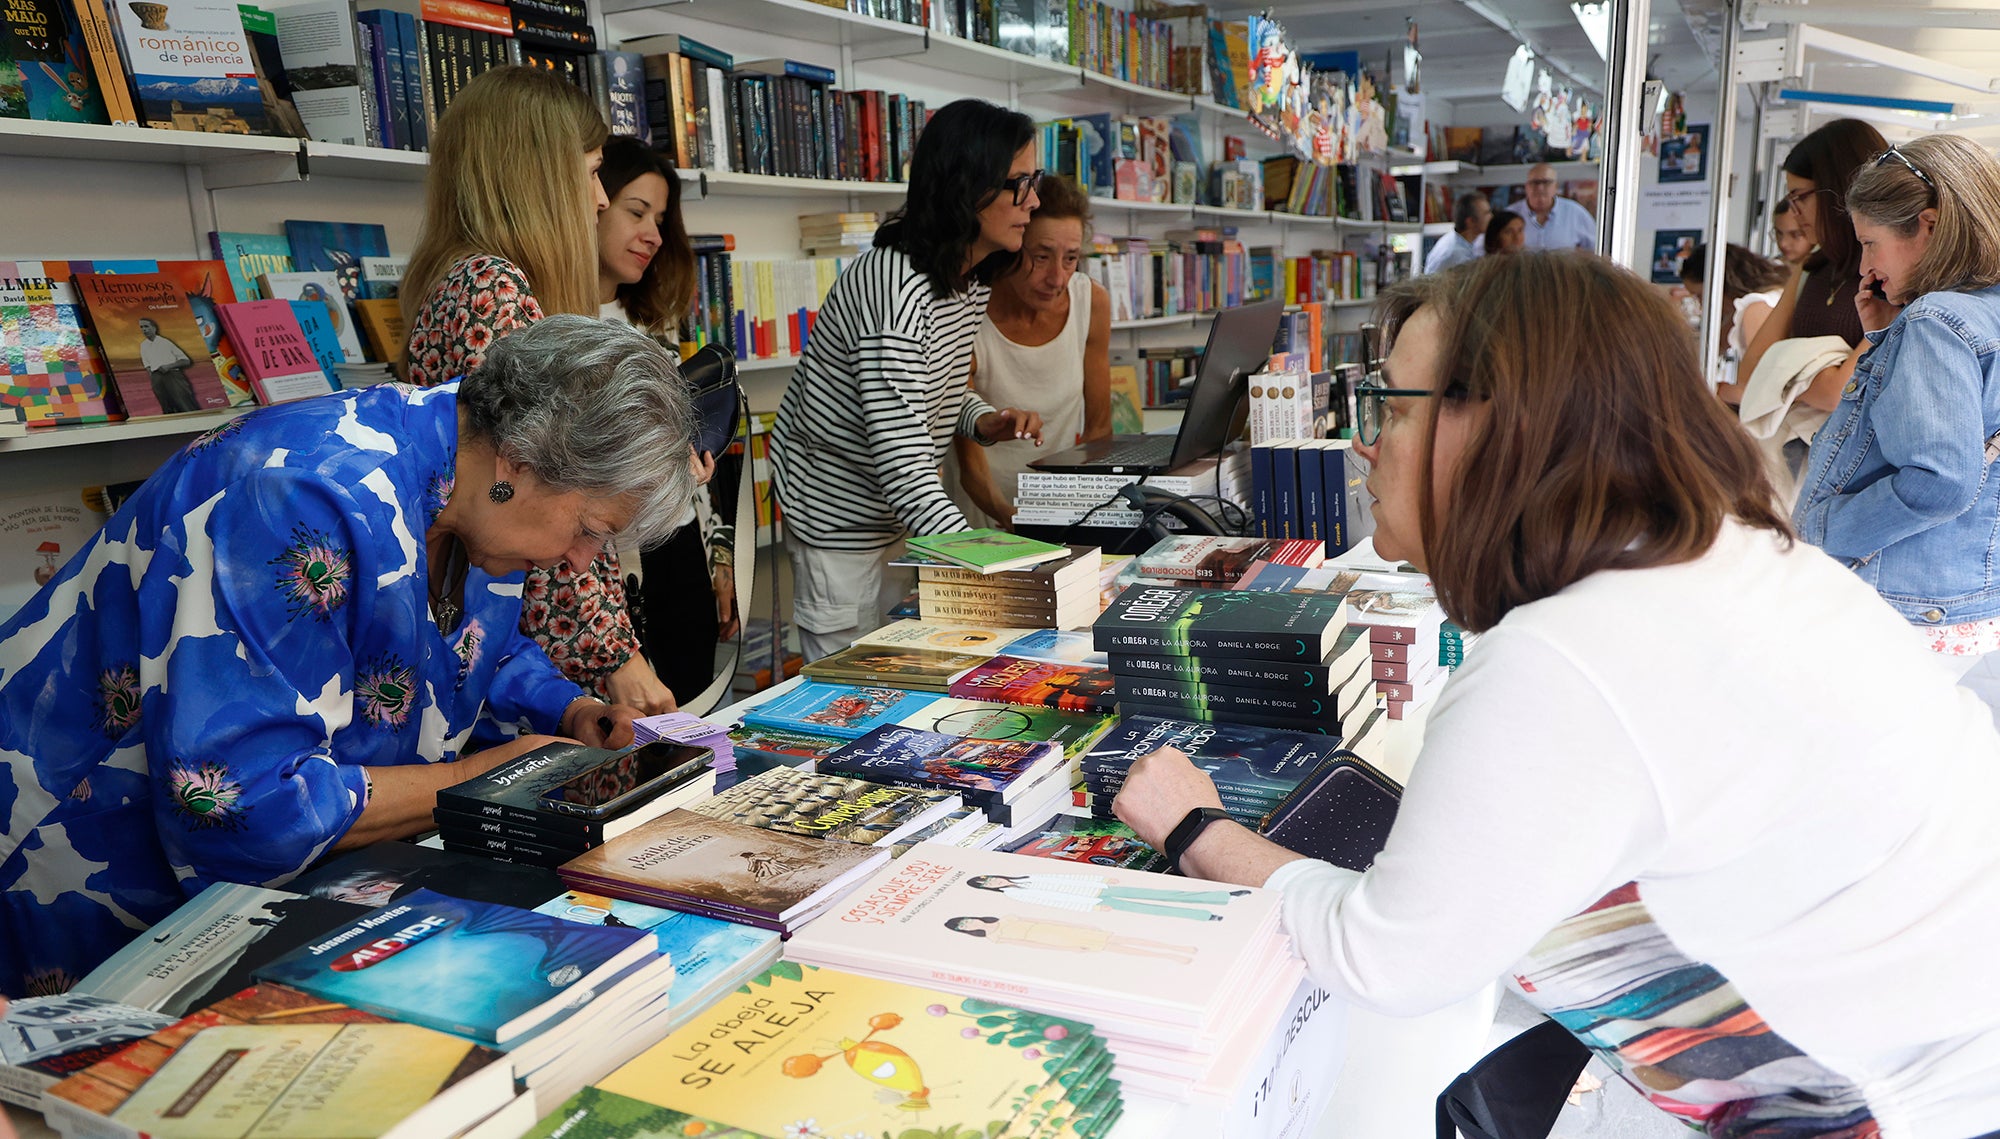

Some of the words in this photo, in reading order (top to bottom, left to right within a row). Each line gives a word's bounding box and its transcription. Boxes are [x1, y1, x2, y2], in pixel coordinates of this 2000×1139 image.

[4, 9, 48, 25] MALO
[14, 28, 31, 36] QUE
[30, 24, 47, 38] TÚ
[138, 35, 240, 53] románico
[159, 51, 178, 62] de
[182, 52, 244, 66] palencia
[90, 279, 174, 293] Hermosos
[3, 295, 25, 303] David
[261, 350, 280, 369] DE
[22, 516, 36, 526] ALTA
[53, 515, 79, 523] MUNDO
[1101, 519, 1118, 527] Tierra
[1140, 566, 1195, 576] COCODRILOS
[1196, 569, 1213, 577] SEIS
[1119, 588, 1181, 621] OMEGA
[1122, 636, 1147, 645] OMEGA
[1150, 638, 1160, 646] DE
[1174, 640, 1208, 648] AURORA
[1217, 640, 1243, 649] DANIEL
[1246, 641, 1253, 649] A.
[1255, 642, 1281, 650] BORGE
[977, 660, 1041, 688] VAQUERO
[1126, 660, 1135, 668] EL
[1136, 661, 1161, 670] OMEGA
[1162, 663, 1172, 671] DE
[1173, 664, 1184, 672] LA
[1185, 665, 1218, 675] AURORA
[1228, 668, 1253, 678] DANIEL
[1255, 670, 1262, 678] A.
[1264, 671, 1289, 680] BORGE
[1132, 687, 1142, 696] EL
[1142, 688, 1167, 698] OMEGA
[1168, 690, 1179, 698] DE
[1180, 691, 1191, 700] LA
[1191, 692, 1225, 703] AURORA
[1235, 696, 1261, 705] DANIEL
[1263, 697, 1270, 705] A.
[1271, 699, 1297, 709] BORGE
[1123, 731, 1140, 741] LA
[1179, 724, 1200, 738] DEL
[853, 728, 923, 757] Cowboy
[1123, 720, 1178, 760] PIONERA
[1184, 729, 1217, 757] UNDO
[1234, 786, 1264, 795] Huidobro
[1239, 796, 1268, 805] Huidobro
[1241, 807, 1270, 816] Huidobro
[627, 843, 672, 863] Baile
[631, 834, 712, 871] Posguerra
[841, 894, 888, 923] COSAS
[878, 876, 911, 894] QUE
[900, 859, 931, 876] SOY
[876, 883, 929, 917] SIEMPRE
[308, 926, 366, 956] Josema
[357, 905, 412, 929] Montes
[147, 963, 165, 977] EN
[164, 953, 179, 963] EL
[180, 913, 234, 951] INTERIOR
[156, 964, 179, 980] DE
[176, 950, 198, 963] LA
[196, 914, 244, 948] NOCHE
[673, 1041, 709, 1061] La
[710, 997, 775, 1041] abeja
[679, 1059, 735, 1089] SE
[733, 988, 836, 1055] ALEJA
